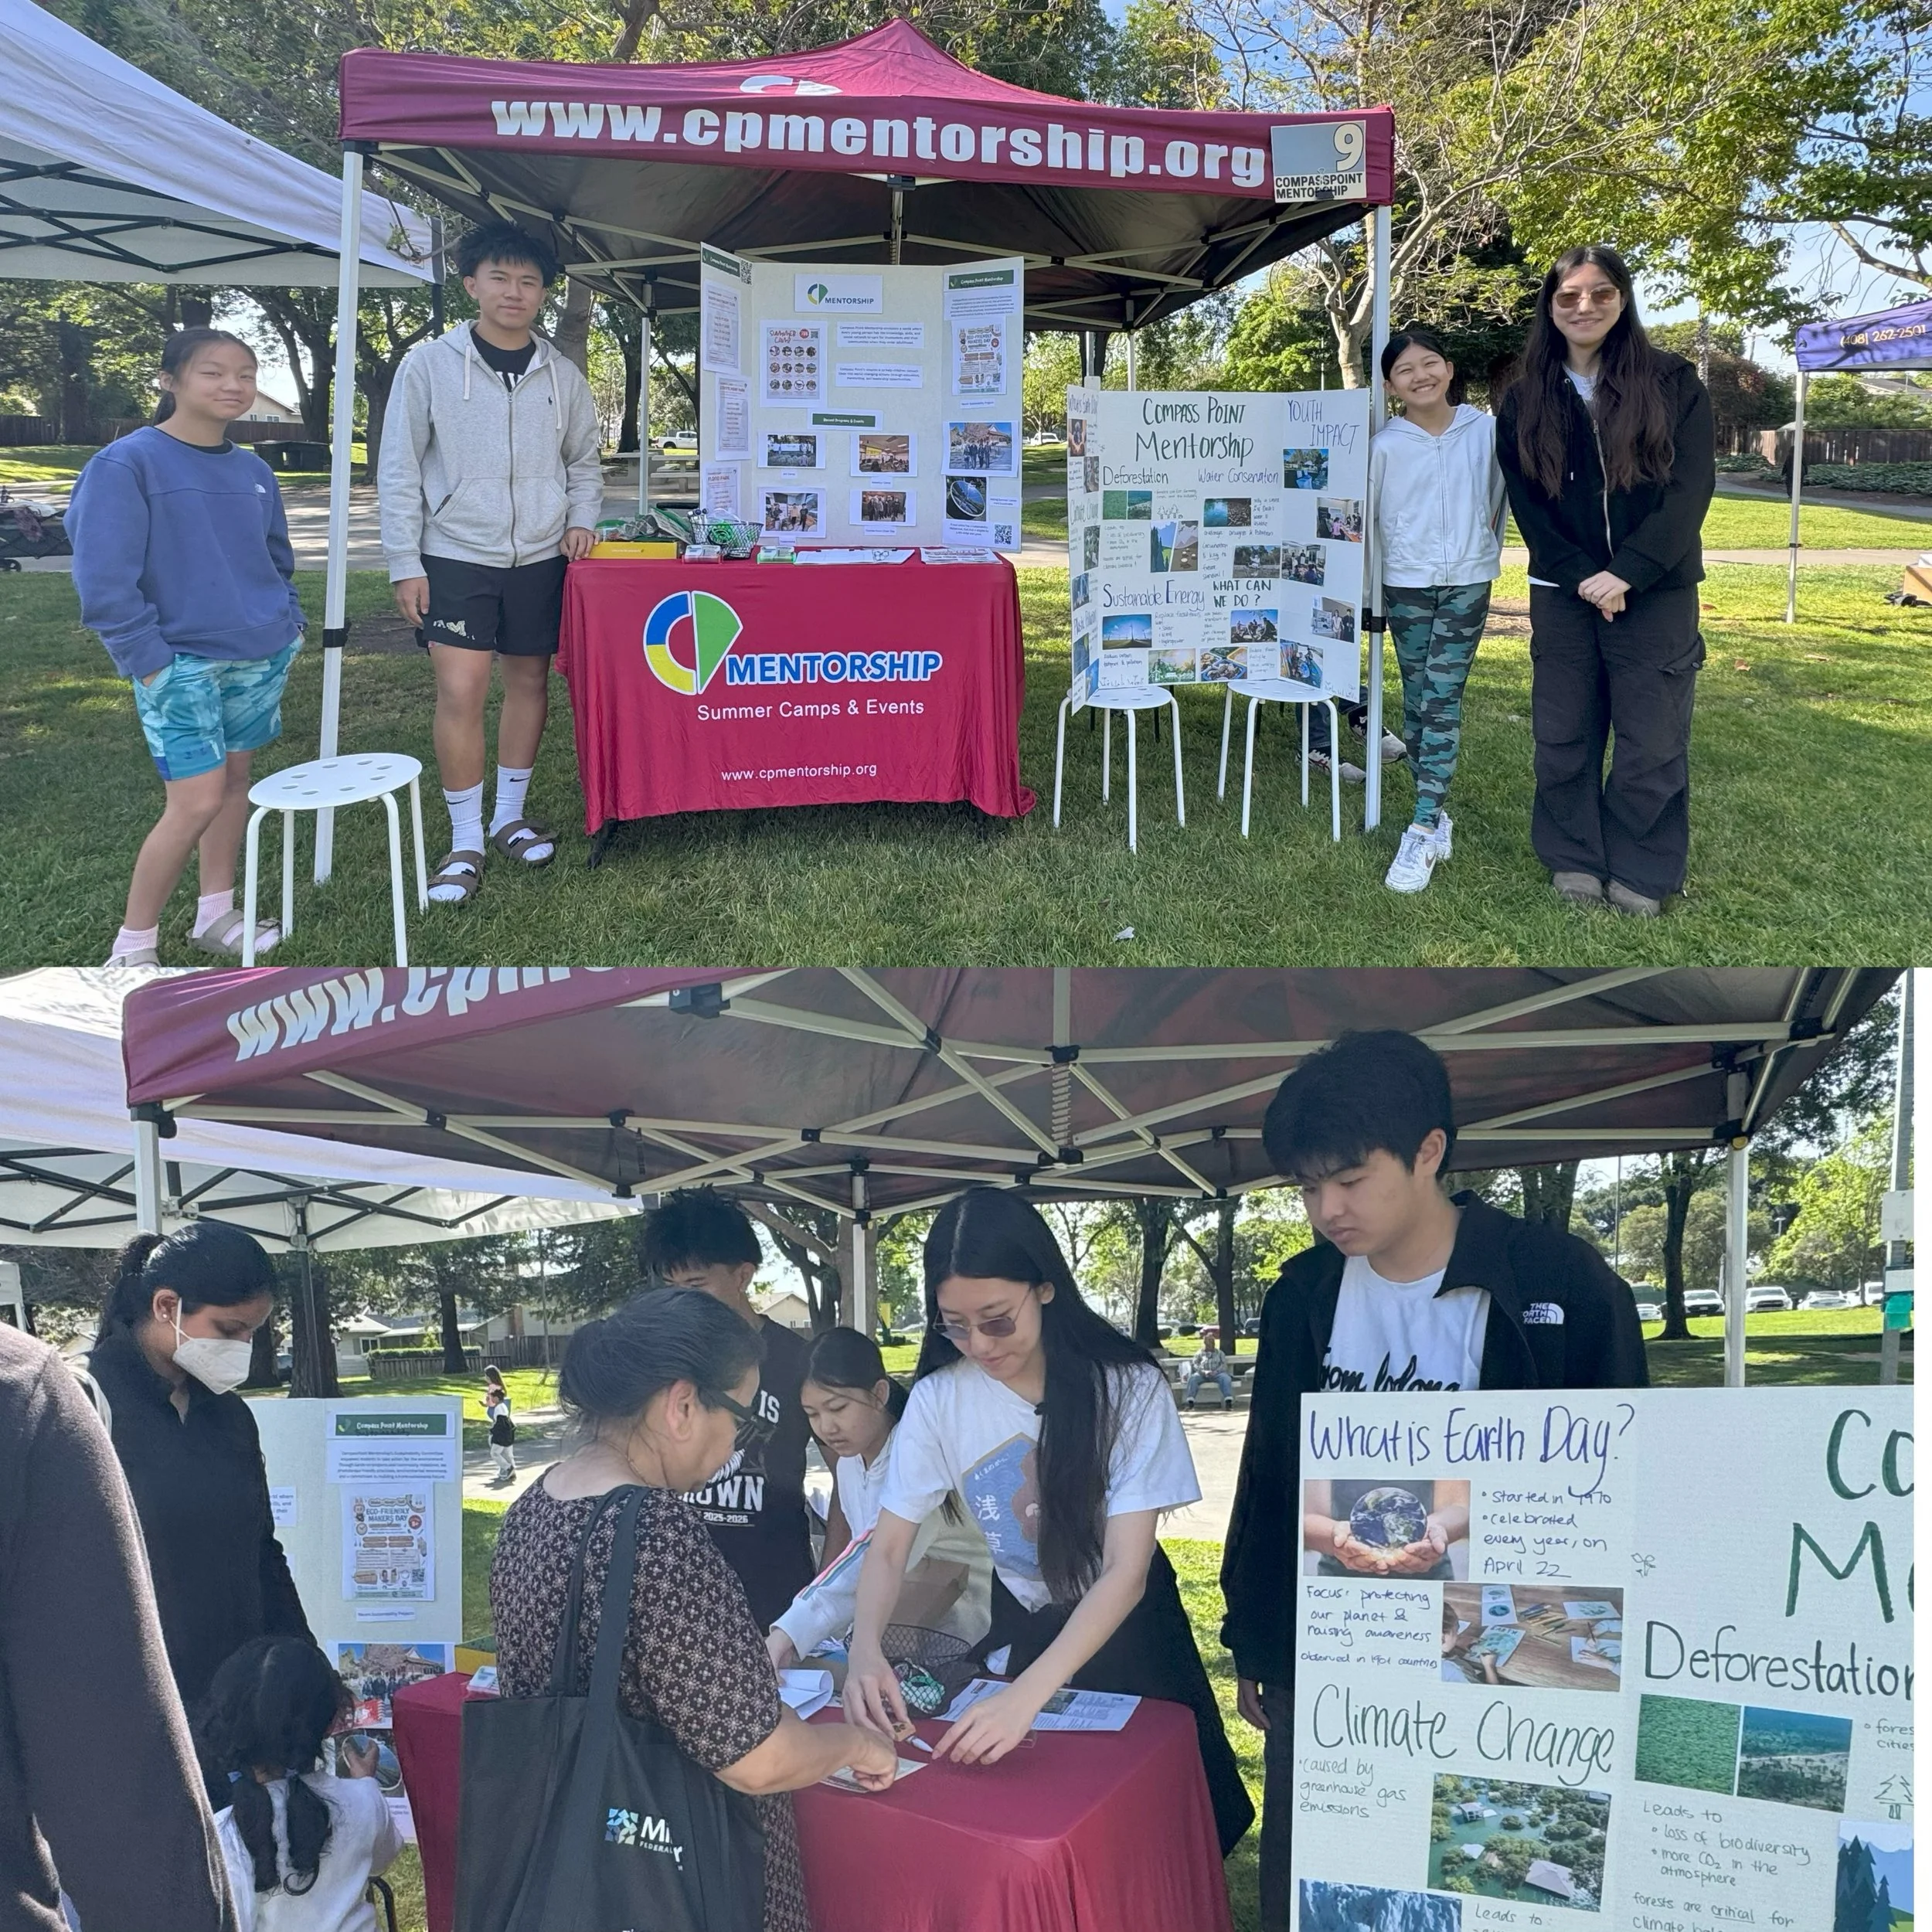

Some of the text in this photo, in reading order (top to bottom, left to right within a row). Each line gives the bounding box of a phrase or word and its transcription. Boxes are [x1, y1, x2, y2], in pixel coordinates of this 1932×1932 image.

[492, 100, 1266, 188] www.cpmentorship.org
[1333, 123, 1364, 172] 9
[1275, 173, 1362, 188] COMPASSPOINT
[1872, 324, 1927, 342] 262-2501
[1287, 400, 1322, 423] YOUTH
[1136, 431, 1253, 467] Mentorship
[1310, 423, 1360, 454] IMPACT
[1103, 464, 1168, 485] Deforestation
[1199, 468, 1223, 483] Water
[1103, 583, 1163, 607] Sustainable
[1165, 580, 1205, 611] Energy
[1213, 580, 1271, 591] WHAT CAN
[1213, 595, 1227, 607] WE
[1233, 594, 1249, 607] DO
[726, 651, 943, 685] MENTORSHIP
[698, 699, 924, 721] Summer Camps & Events
[721, 764, 877, 781] www.cpmentorship.org
[1311, 1403, 1634, 1498] What is Earth Day?
[678, 1475, 764, 1512] OWN
[1492, 1490, 1546, 1503] Started
[1552, 1495, 1563, 1504] in
[703, 1512, 748, 1524] 2025-2026
[1484, 1534, 1607, 1555] every year, on
[1484, 1557, 1572, 1578] April 22
[1785, 1521, 1914, 1624] M
[1360, 1589, 1430, 1610] protecting
[1311, 1608, 1408, 1628] our planet &
[1366, 1629, 1431, 1642] awareness
[1314, 1684, 1614, 1786] Climate Change
[1356, 1760, 1374, 1786] by
[1300, 1781, 1407, 1808] greenhouse gas
[1300, 1801, 1369, 1818] emissions
[1644, 1801, 1723, 1823] Leads to
[640, 1841, 673, 1854] FEDERAL
[1665, 1824, 1811, 1866] loss of biodiversity
[1662, 1849, 1691, 1862] more
[1732, 1859, 1743, 1869] in
[1751, 1861, 1777, 1876] the
[1661, 1866, 1736, 1887] atmosphere
[1475, 1903, 1517, 1923] Leads
[1633, 1892, 1794, 1928] forests are critical for
